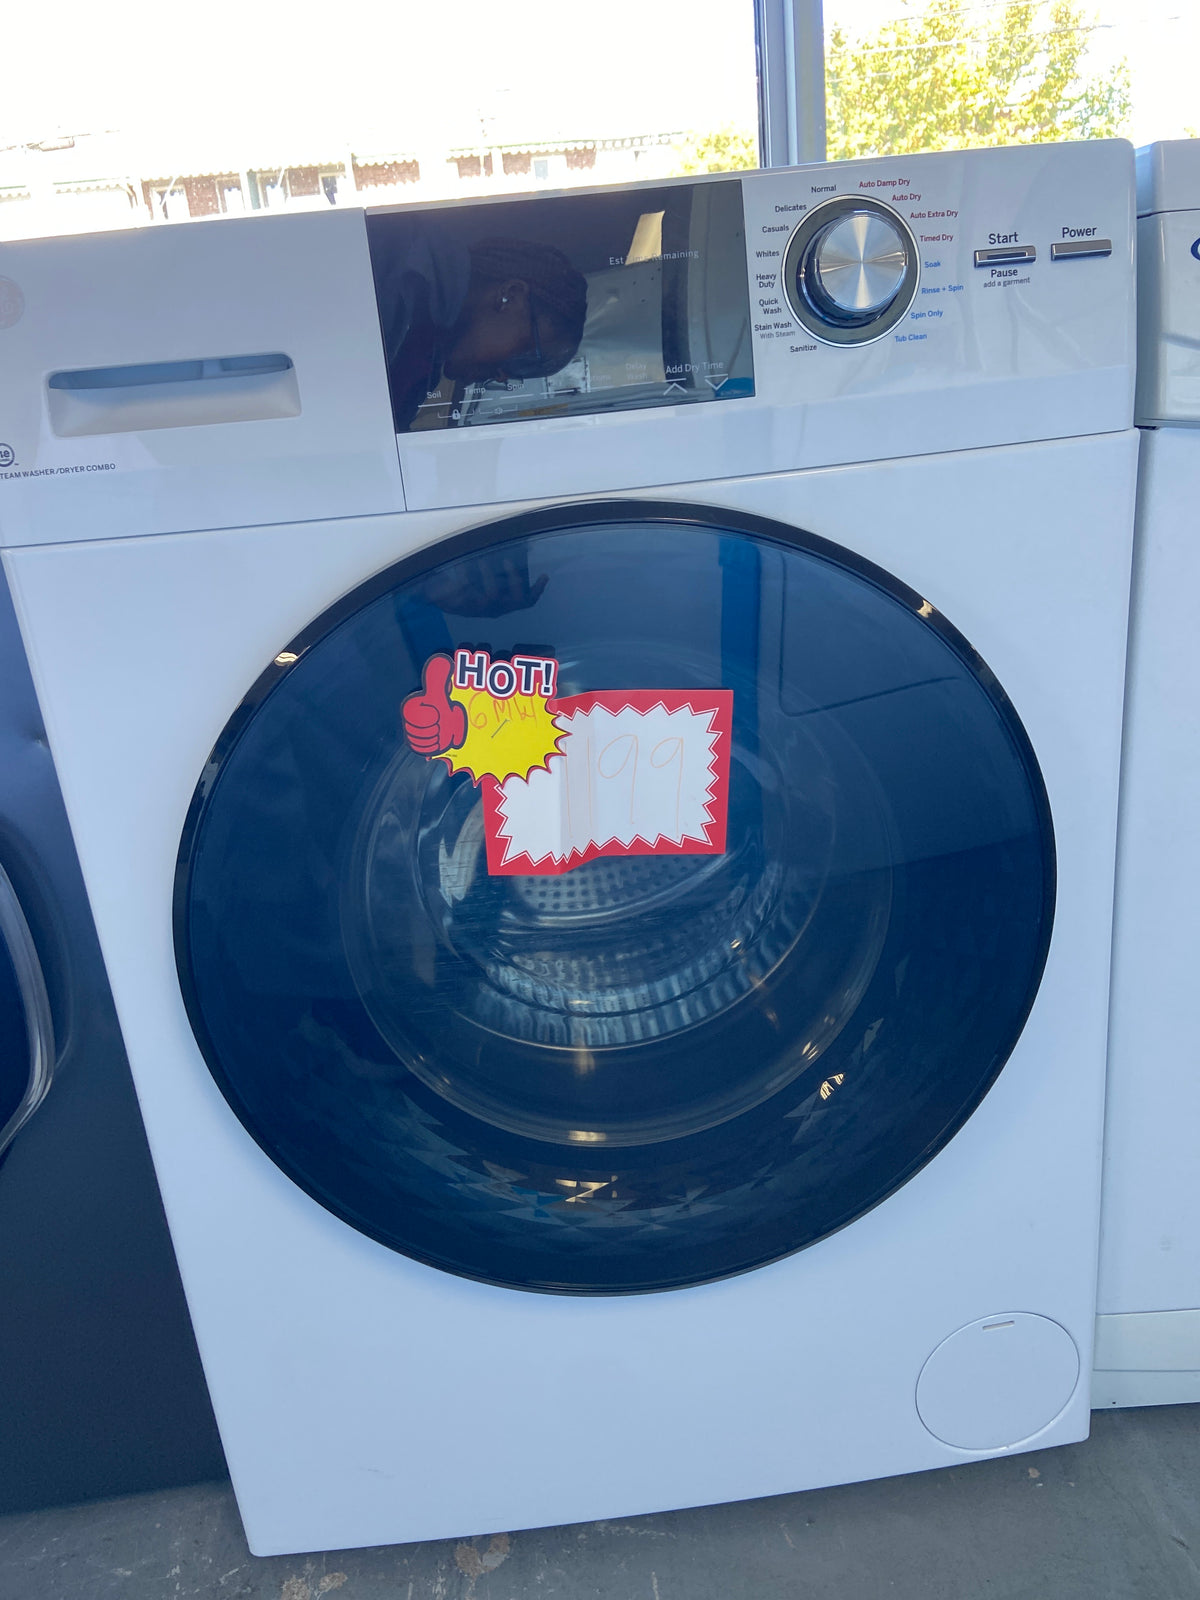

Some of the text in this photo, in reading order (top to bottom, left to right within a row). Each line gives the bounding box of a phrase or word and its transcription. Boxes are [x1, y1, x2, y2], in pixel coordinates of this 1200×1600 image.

[859, 178, 910, 188] Auto Damp Dry
[811, 185, 836, 193] Normal
[909, 193, 921, 201] Dry
[775, 204, 807, 213] Delicates
[946, 210, 958, 218] Dry
[762, 225, 789, 233] Casuals
[1062, 227, 1097, 238] Power
[943, 234, 953, 242] Dry
[988, 231, 1019, 245] Start
[756, 250, 779, 258] Whites
[609, 256, 623, 265] Est
[756, 273, 776, 282] Heavy
[991, 269, 1018, 278] Pause
[759, 281, 775, 289] Duty
[983, 280, 996, 288] add
[1003, 277, 1030, 287] garment
[921, 286, 941, 294] Rinse
[947, 284, 964, 294] Spin
[759, 298, 778, 306] Quick
[763, 307, 782, 315] Wash
[911, 310, 943, 320] Spin Only
[755, 321, 792, 331] Stain Wash
[760, 331, 773, 339] With
[909, 333, 927, 341] Clean
[790, 344, 817, 353] Sanitize
[666, 365, 682, 374] Add
[685, 364, 699, 372] Dry
[427, 391, 441, 399] Soil
[23, 466, 85, 477] WASHER/DRYER
[86, 463, 116, 472] COMBO
[456, 651, 555, 698] HOT!
